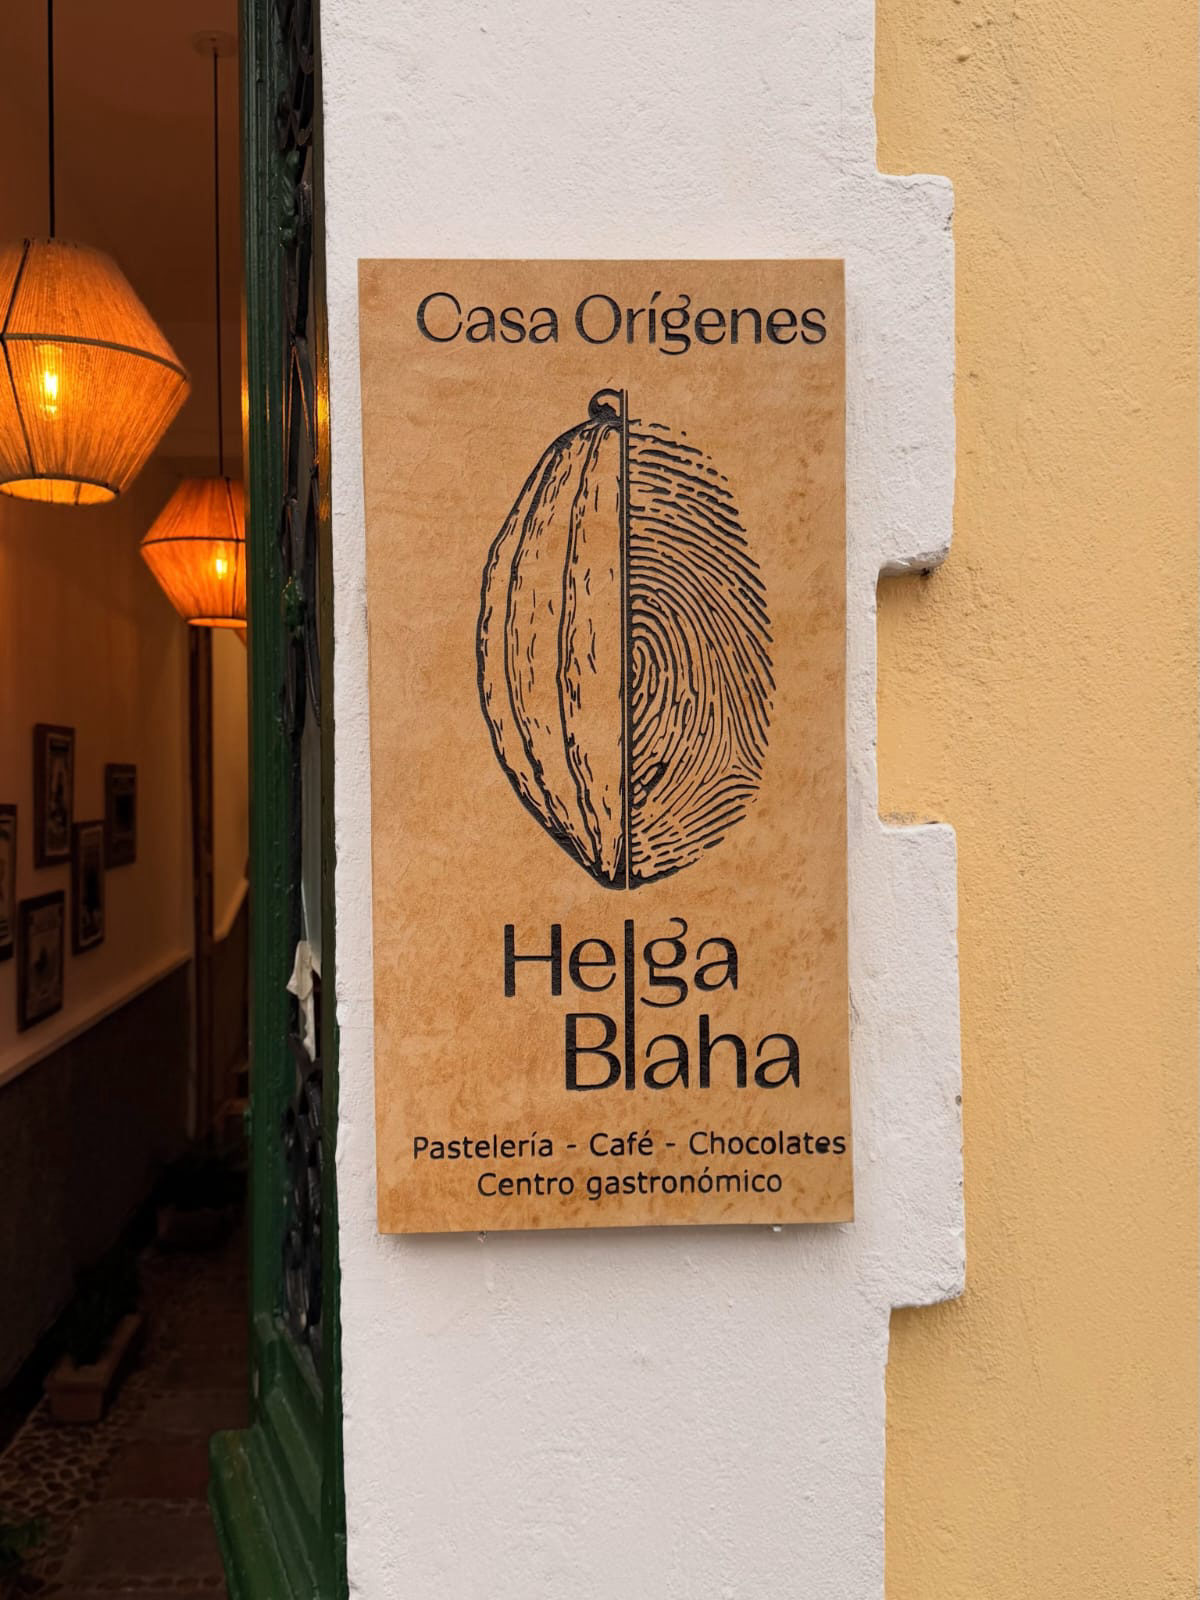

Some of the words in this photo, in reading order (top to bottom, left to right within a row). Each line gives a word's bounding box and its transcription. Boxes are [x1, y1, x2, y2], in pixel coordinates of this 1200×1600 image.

[416, 291, 559, 344] Casa
[574, 290, 827, 356] Orígenes
[503, 916, 739, 1009] Helga
[564, 1012, 801, 1092] Blaha
[413, 1130, 554, 1160] Pastelería
[589, 1129, 654, 1157] Café
[688, 1129, 847, 1156] Chocolates
[477, 1172, 576, 1198] Centro
[586, 1165, 783, 1202] gastronómico
